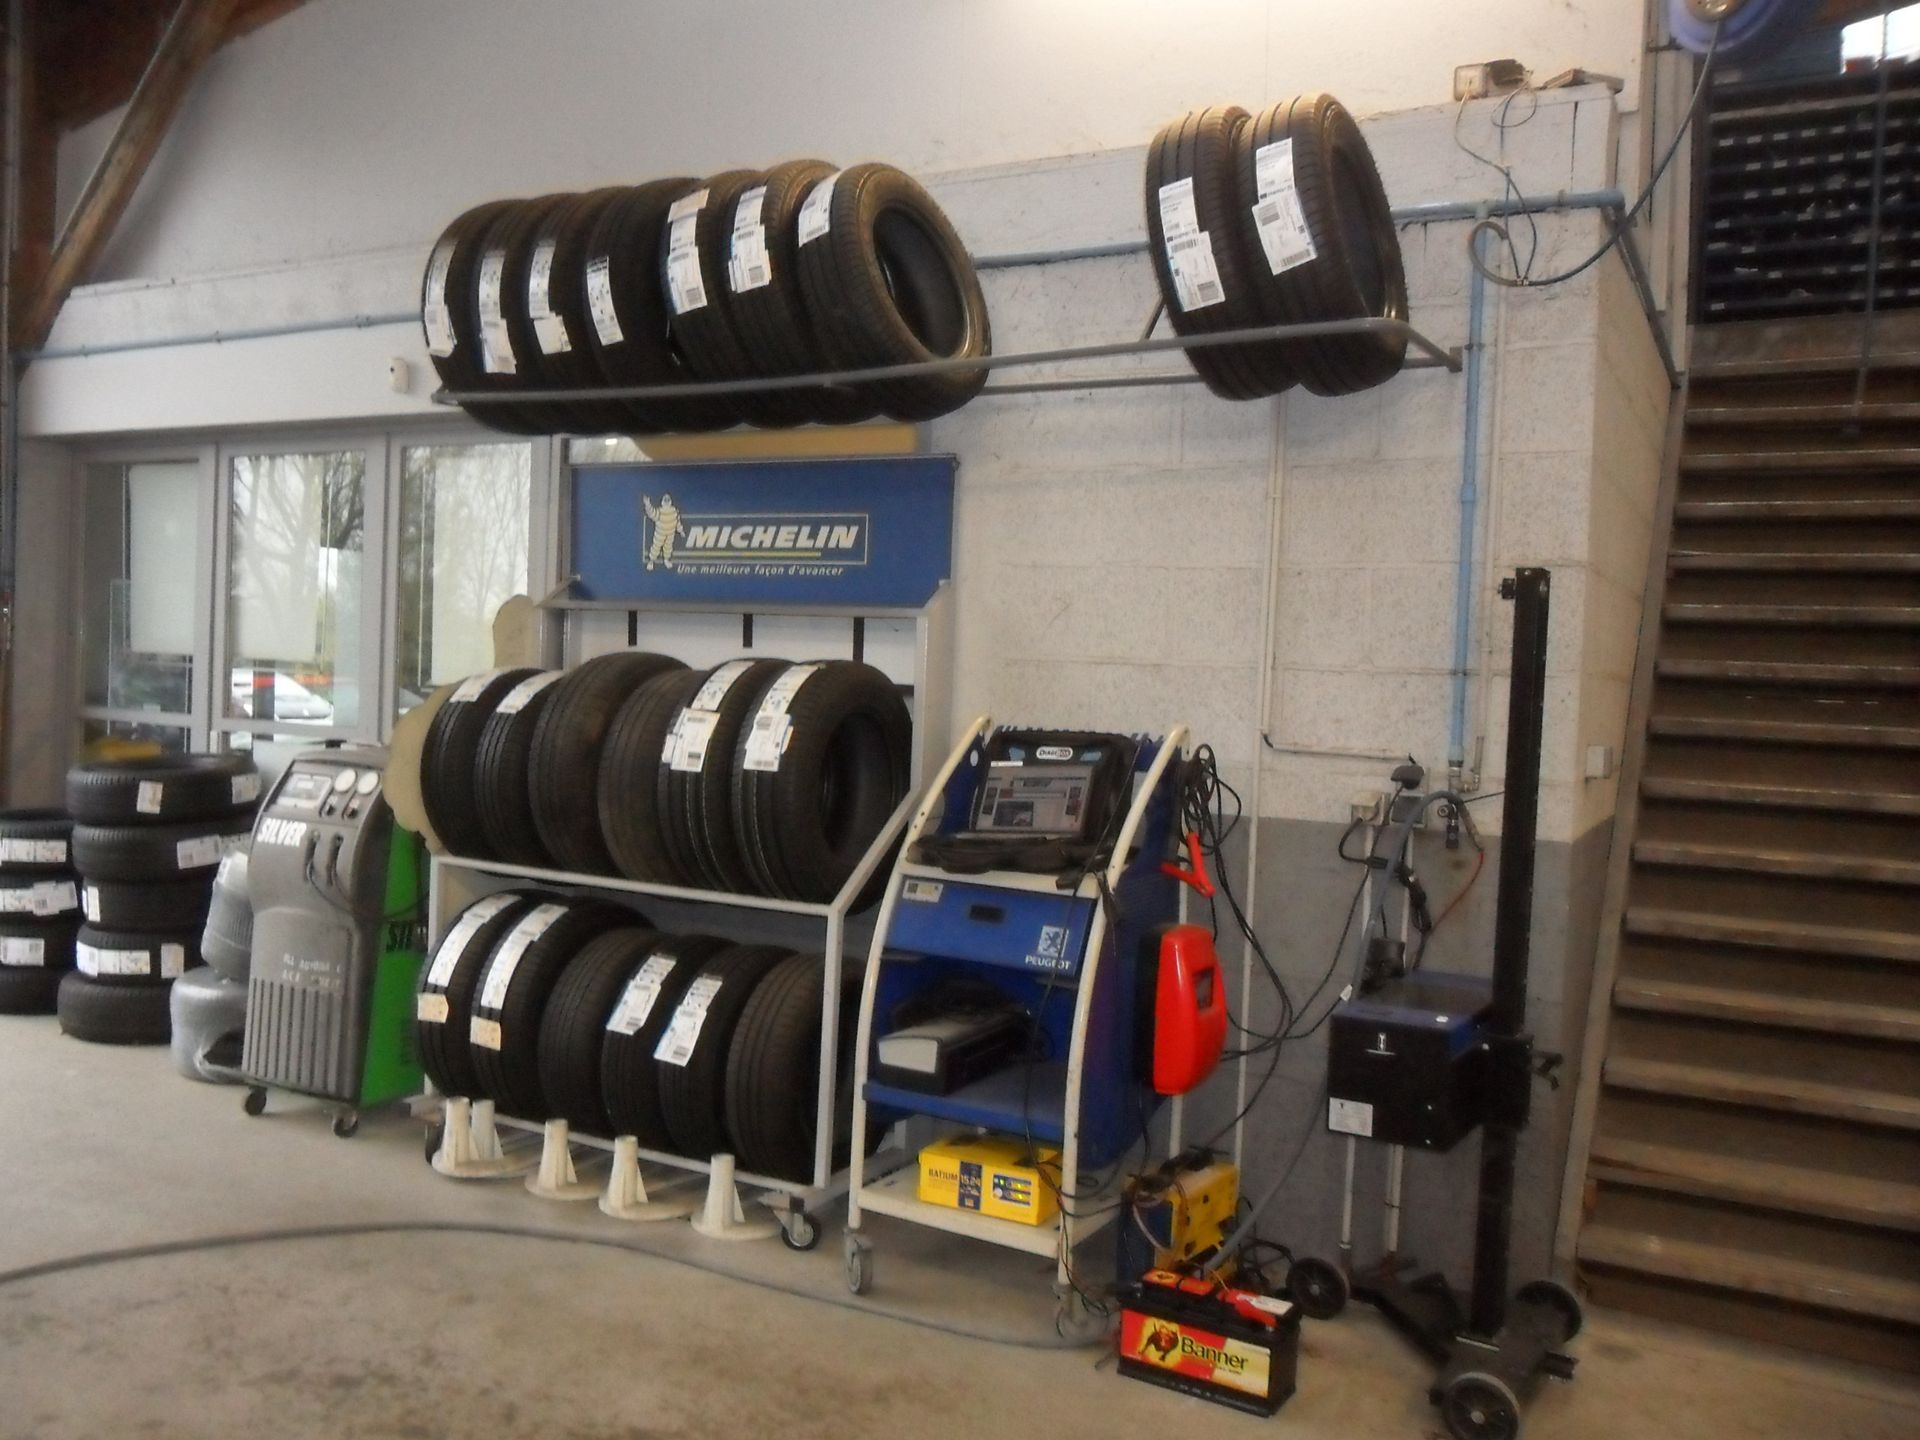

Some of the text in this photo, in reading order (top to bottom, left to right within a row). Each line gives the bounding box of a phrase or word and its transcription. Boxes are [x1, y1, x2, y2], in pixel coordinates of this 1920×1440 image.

[685, 525, 859, 549] MICHELIN
[677, 564, 844, 577] Une meilleure façon d'avancer
[257, 817, 307, 848] SILVER
[1025, 954, 1071, 970] PEUGEOT
[1181, 1336, 1248, 1370] Banner
